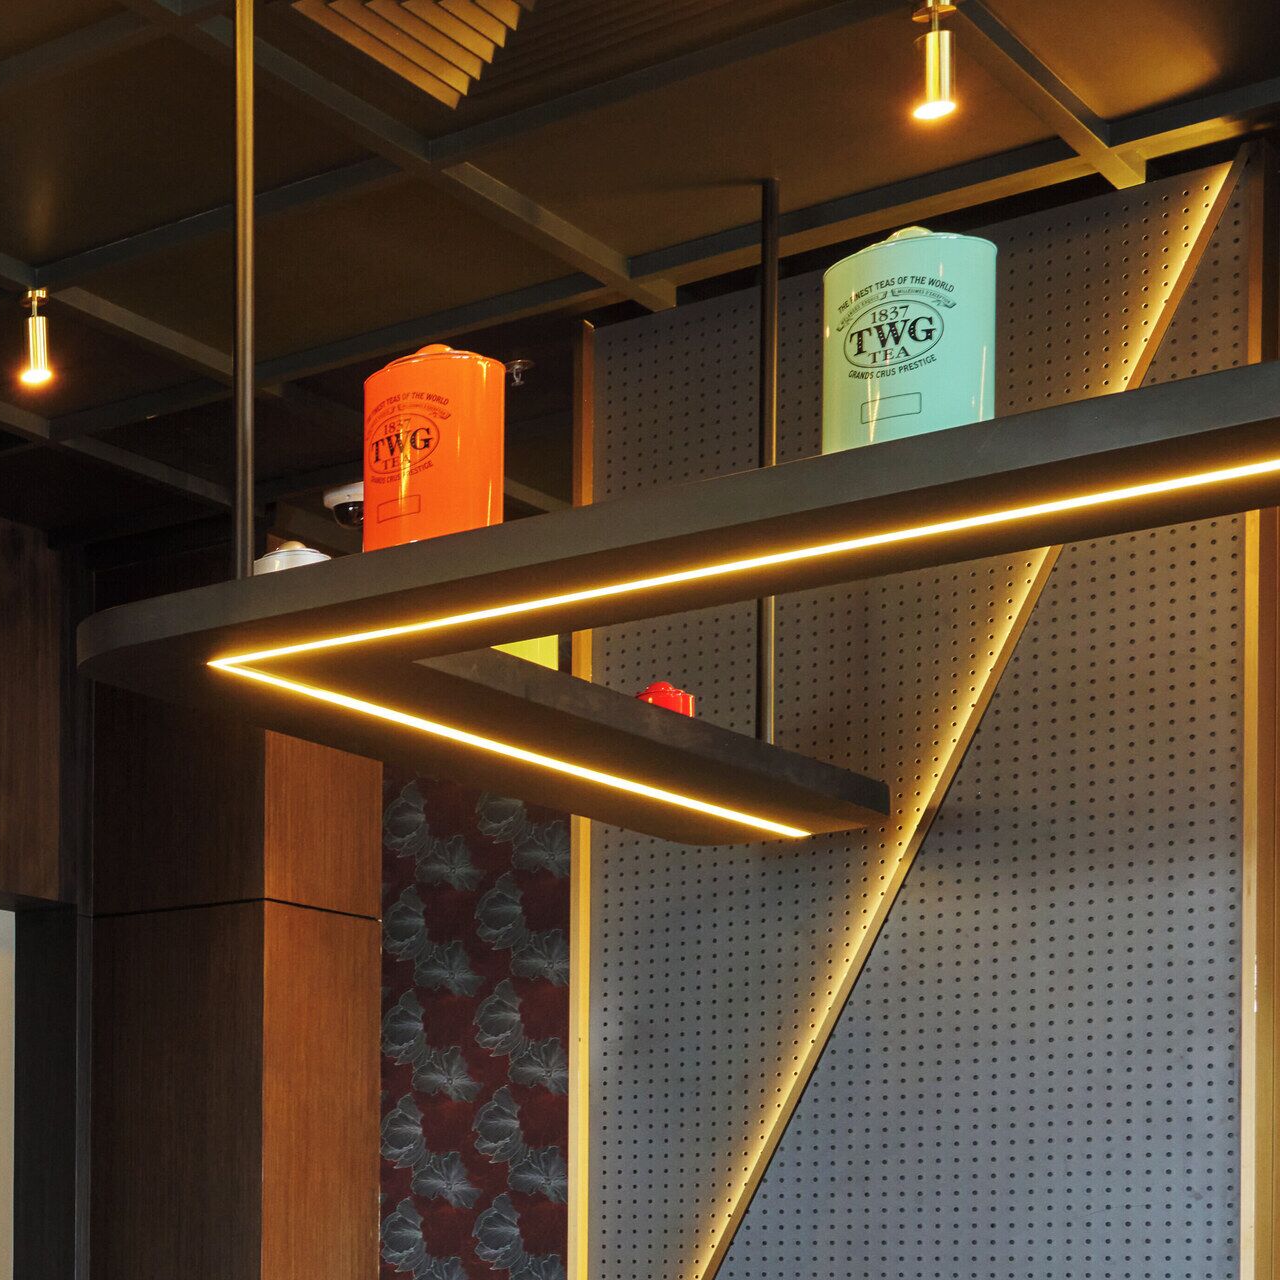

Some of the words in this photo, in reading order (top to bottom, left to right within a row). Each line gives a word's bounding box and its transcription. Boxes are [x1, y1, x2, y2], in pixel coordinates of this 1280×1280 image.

[838, 300, 850, 314] THE
[849, 284, 873, 304] FNEST
[874, 277, 895, 290] TEAS
[897, 276, 908, 285] OF
[910, 275, 927, 285] THE
[928, 277, 955, 293] WORLD
[871, 305, 910, 324] 1837
[849, 316, 937, 357] TWG
[867, 346, 911, 364] TEA
[848, 369, 875, 380] GRANDS
[876, 367, 897, 379] CRUS
[898, 354, 938, 374] PRESTIGE
[386, 394, 401, 405] TEAS
[402, 392, 410, 400] OF
[411, 391, 425, 400] THE
[426, 393, 450, 406] WORLD
[372, 427, 433, 464] TWG
[382, 454, 411, 471] TEA
